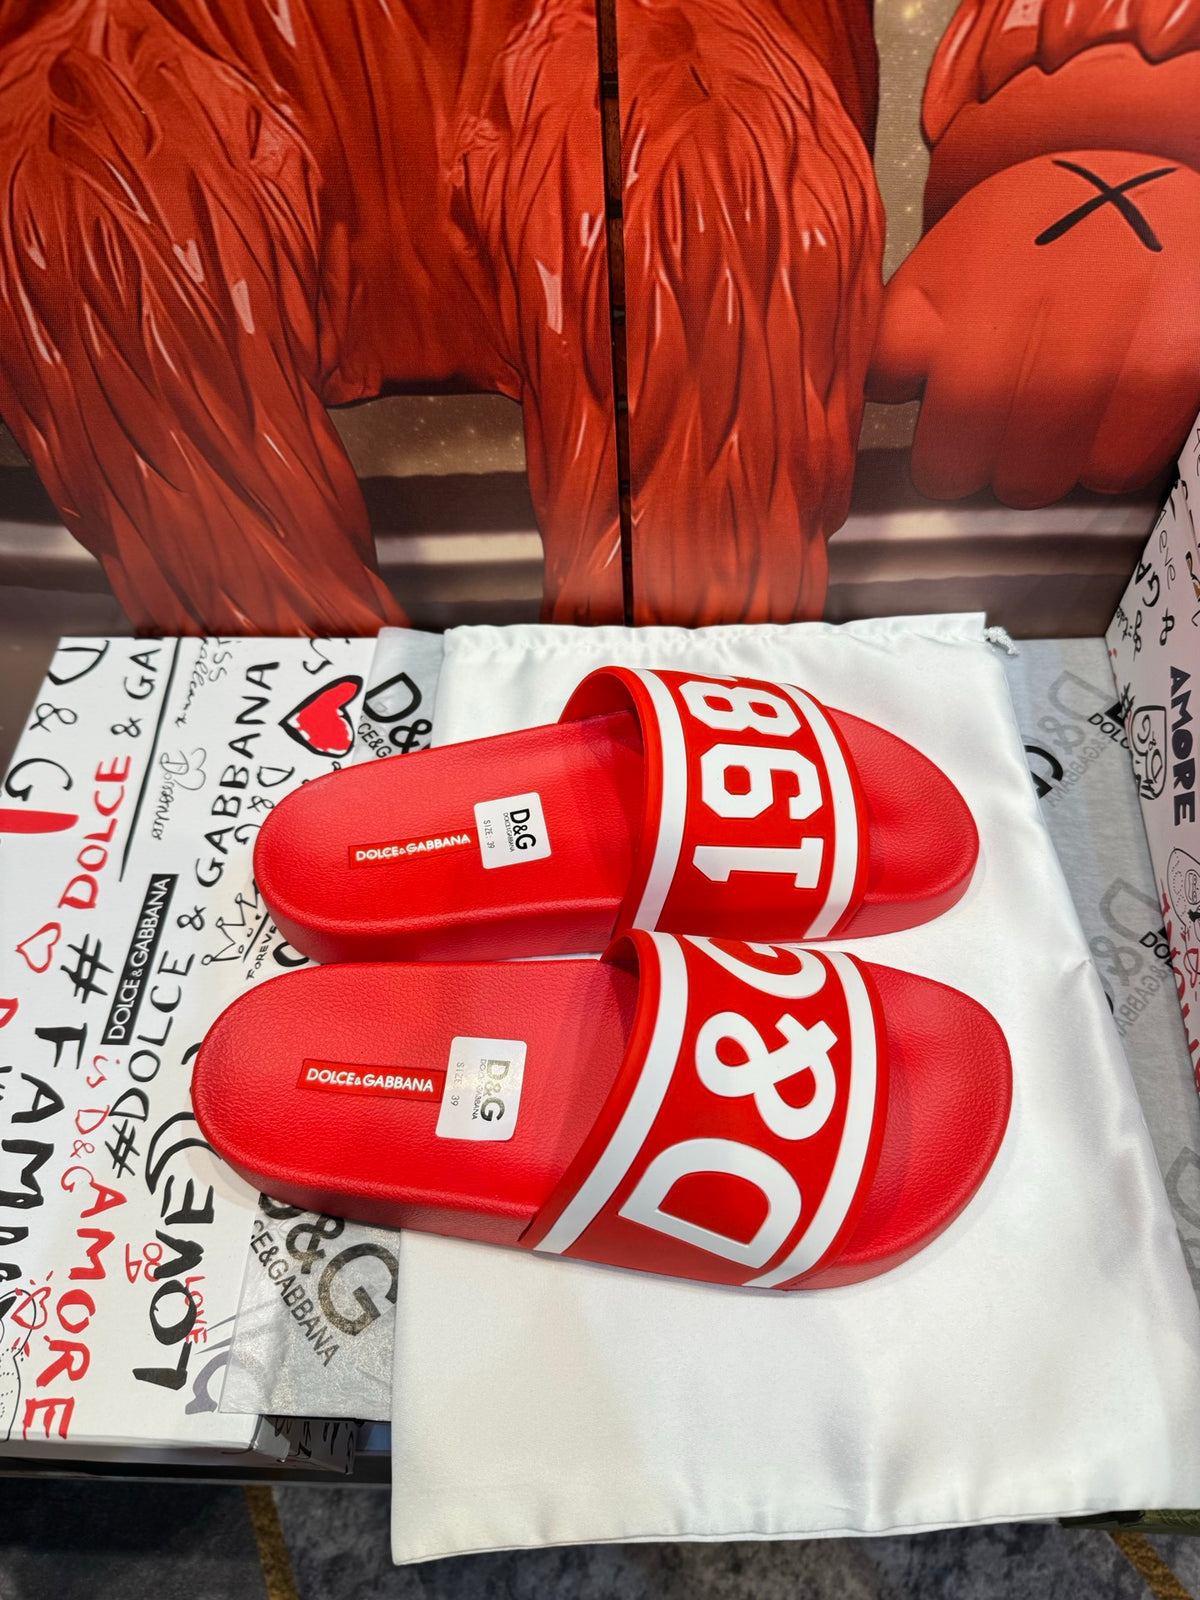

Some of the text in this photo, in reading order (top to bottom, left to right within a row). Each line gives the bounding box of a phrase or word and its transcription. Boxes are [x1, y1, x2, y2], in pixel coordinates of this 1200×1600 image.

[1135, 561, 1160, 607] GA
[57, 637, 163, 909] DOLCE & GA
[1170, 665, 1196, 827] AMORE
[177, 906, 207, 931] &
[195, 661, 281, 887] GABBANA
[678, 673, 823, 889] 198
[355, 834, 471, 861] DOLCE&GABBANA
[510, 808, 536, 850] D&G
[245, 925, 277, 980] FOREVE
[306, 1067, 434, 1093] DOLCE&GABBANA
[480, 1059, 511, 1121] D&G
[24, 1182, 128, 1440] AMORE
